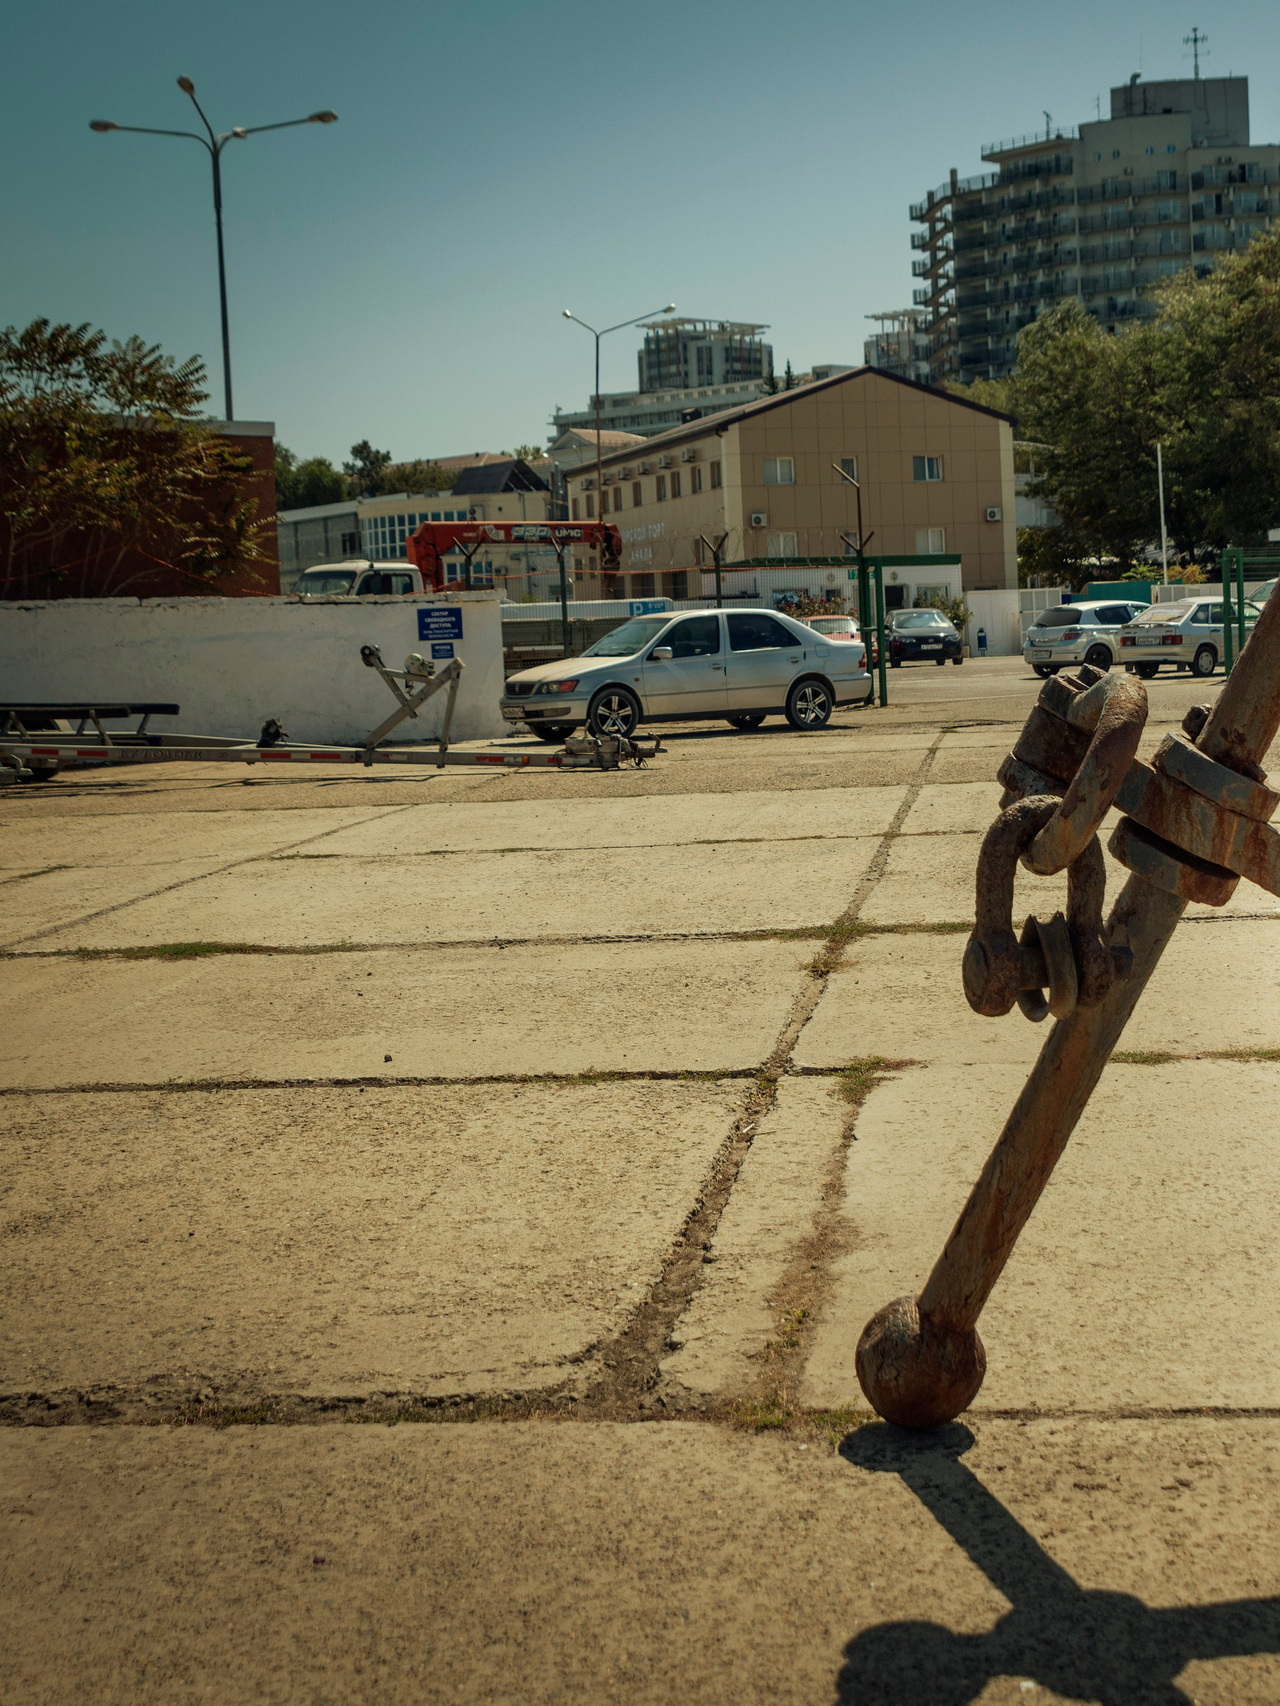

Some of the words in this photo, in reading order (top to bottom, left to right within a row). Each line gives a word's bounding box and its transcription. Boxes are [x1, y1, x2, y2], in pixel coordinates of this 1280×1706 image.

[514, 527, 548, 537] 330
[555, 528, 582, 538] UNIC
[621, 524, 646, 544] ОРСКОЙ
[631, 547, 653, 562] АНАПА
